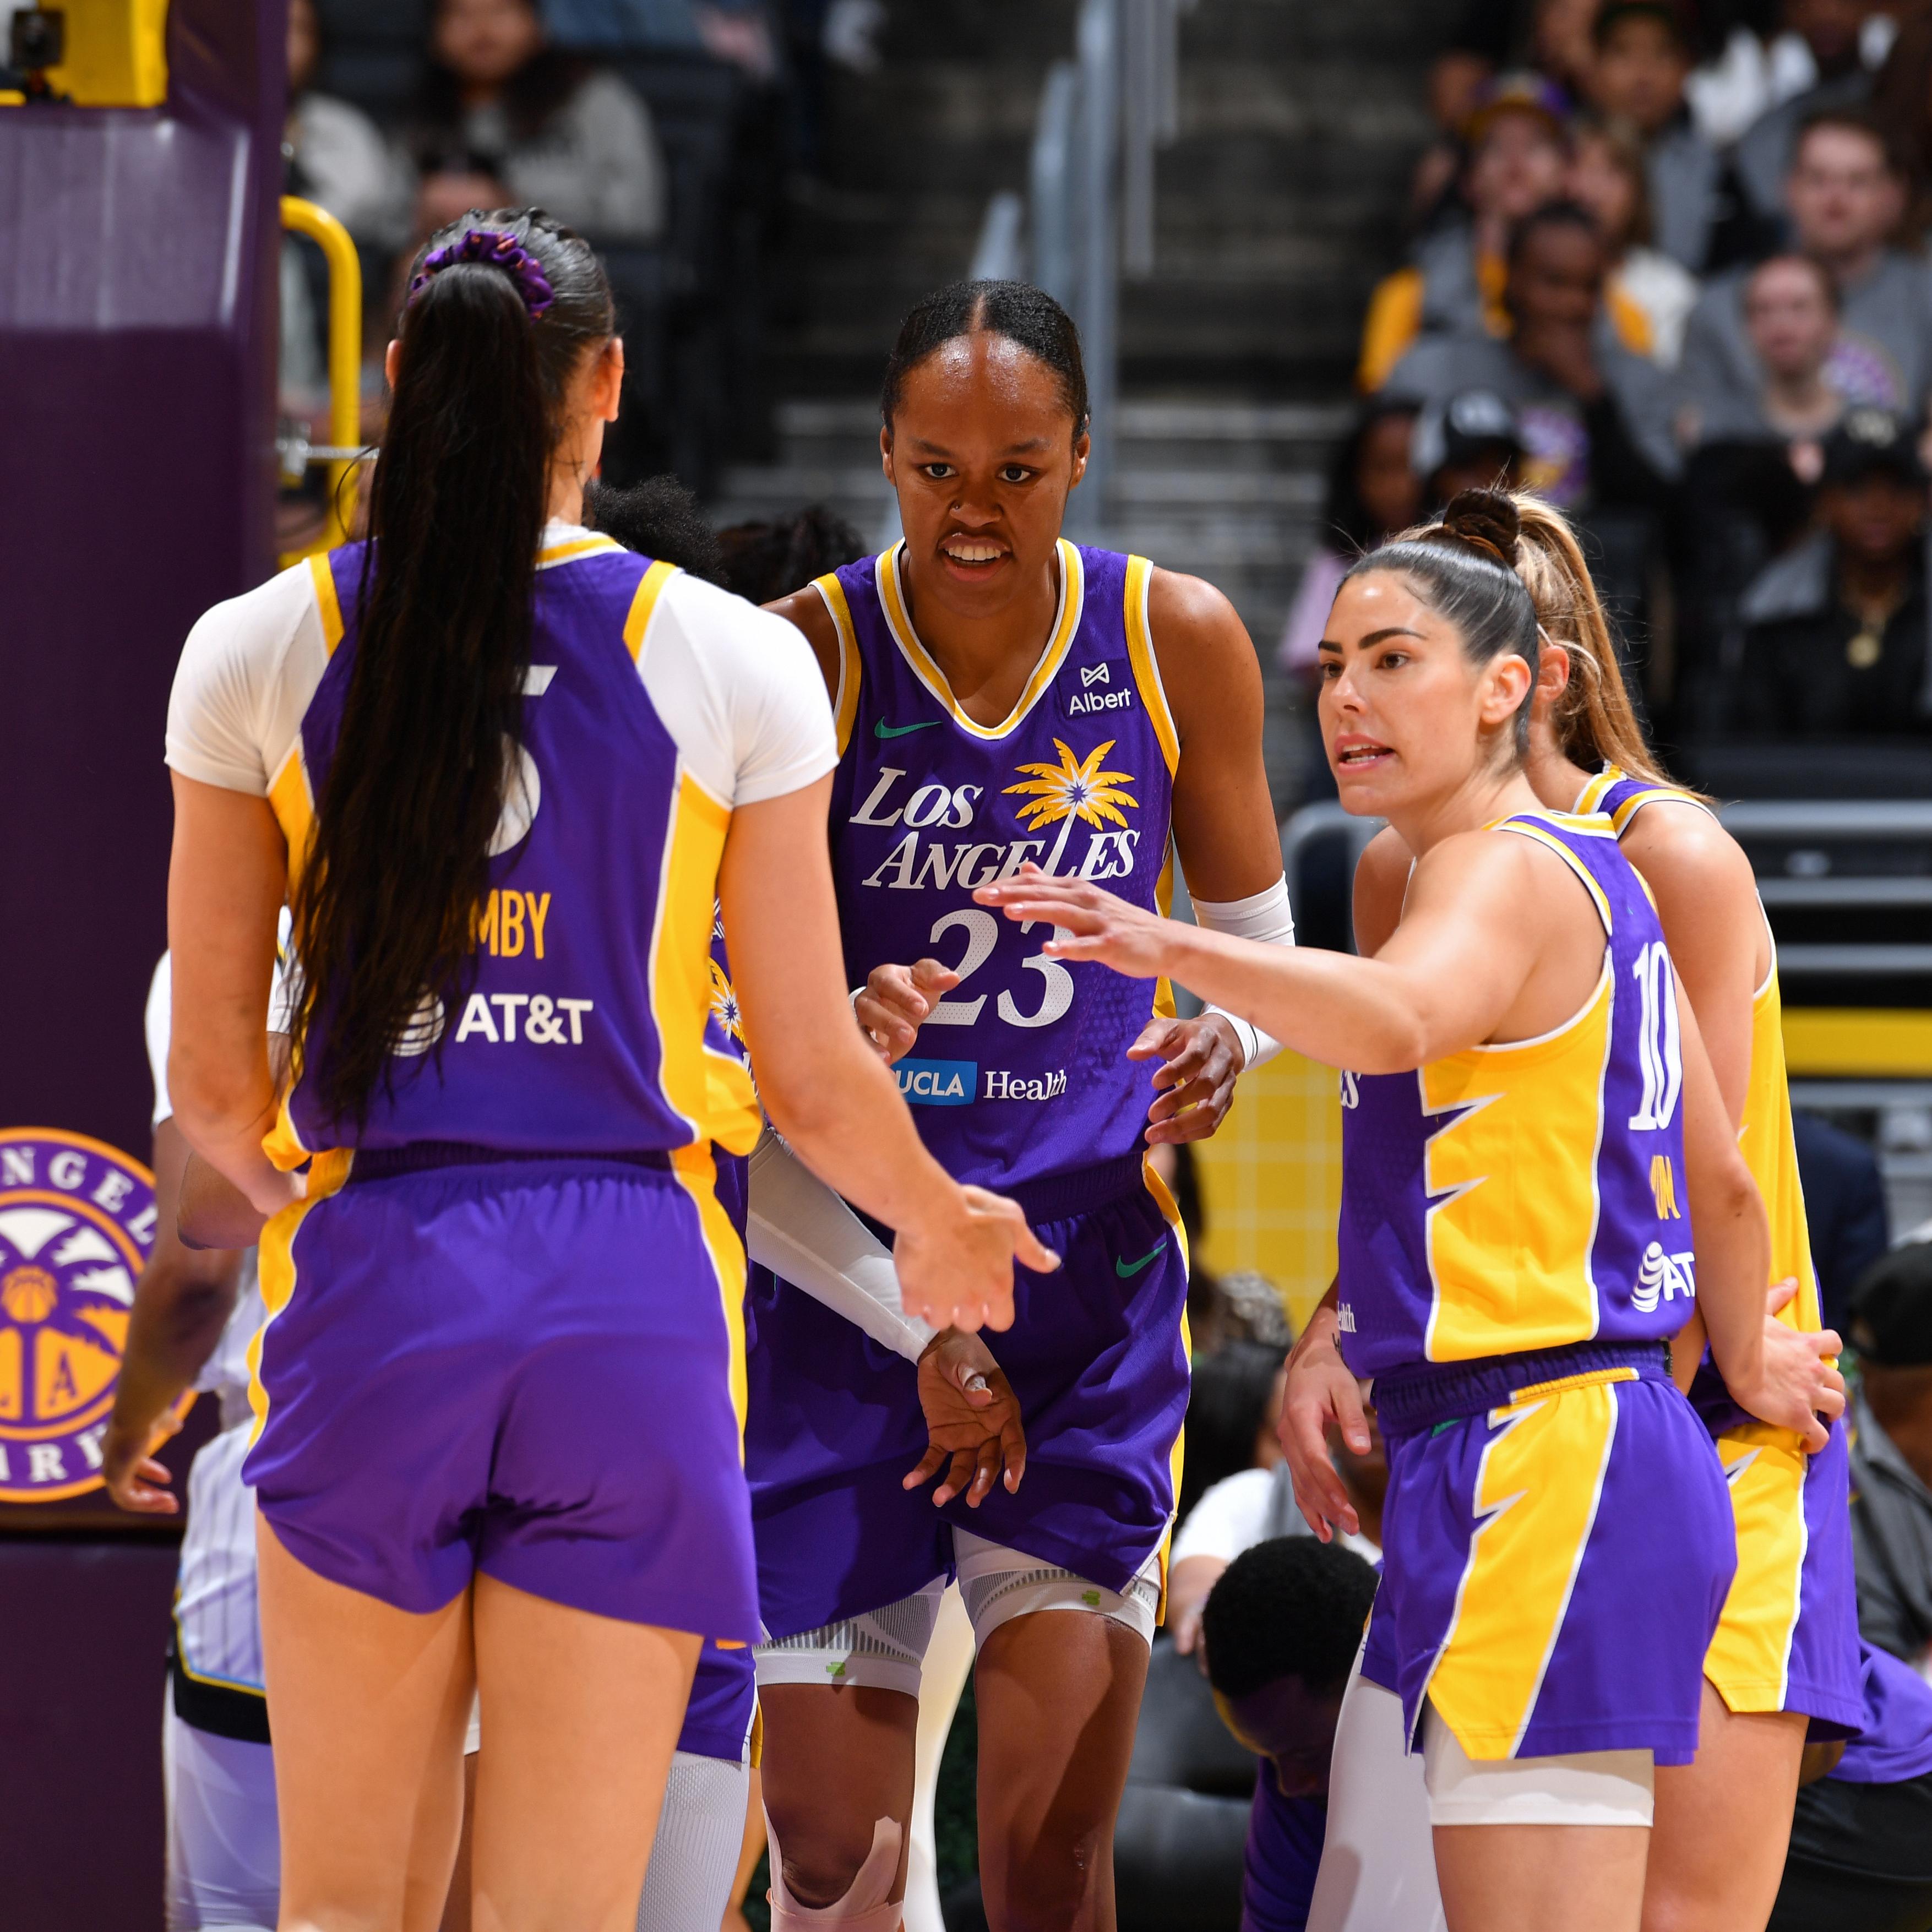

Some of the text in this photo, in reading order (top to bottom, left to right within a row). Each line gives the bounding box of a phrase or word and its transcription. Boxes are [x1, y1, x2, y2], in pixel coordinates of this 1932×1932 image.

[1069, 687, 1131, 715] Albert
[848, 766, 984, 829] LOS
[467, 888, 551, 960] MBY
[923, 909, 1075, 1027] 23
[455, 993, 594, 1044] AT&T
[1628, 940, 1683, 1130] 10
[895, 1069, 1068, 1101] UCLA Health
[1, 1146, 158, 1245] NGEL
[1663, 1251, 1695, 1301] AT
